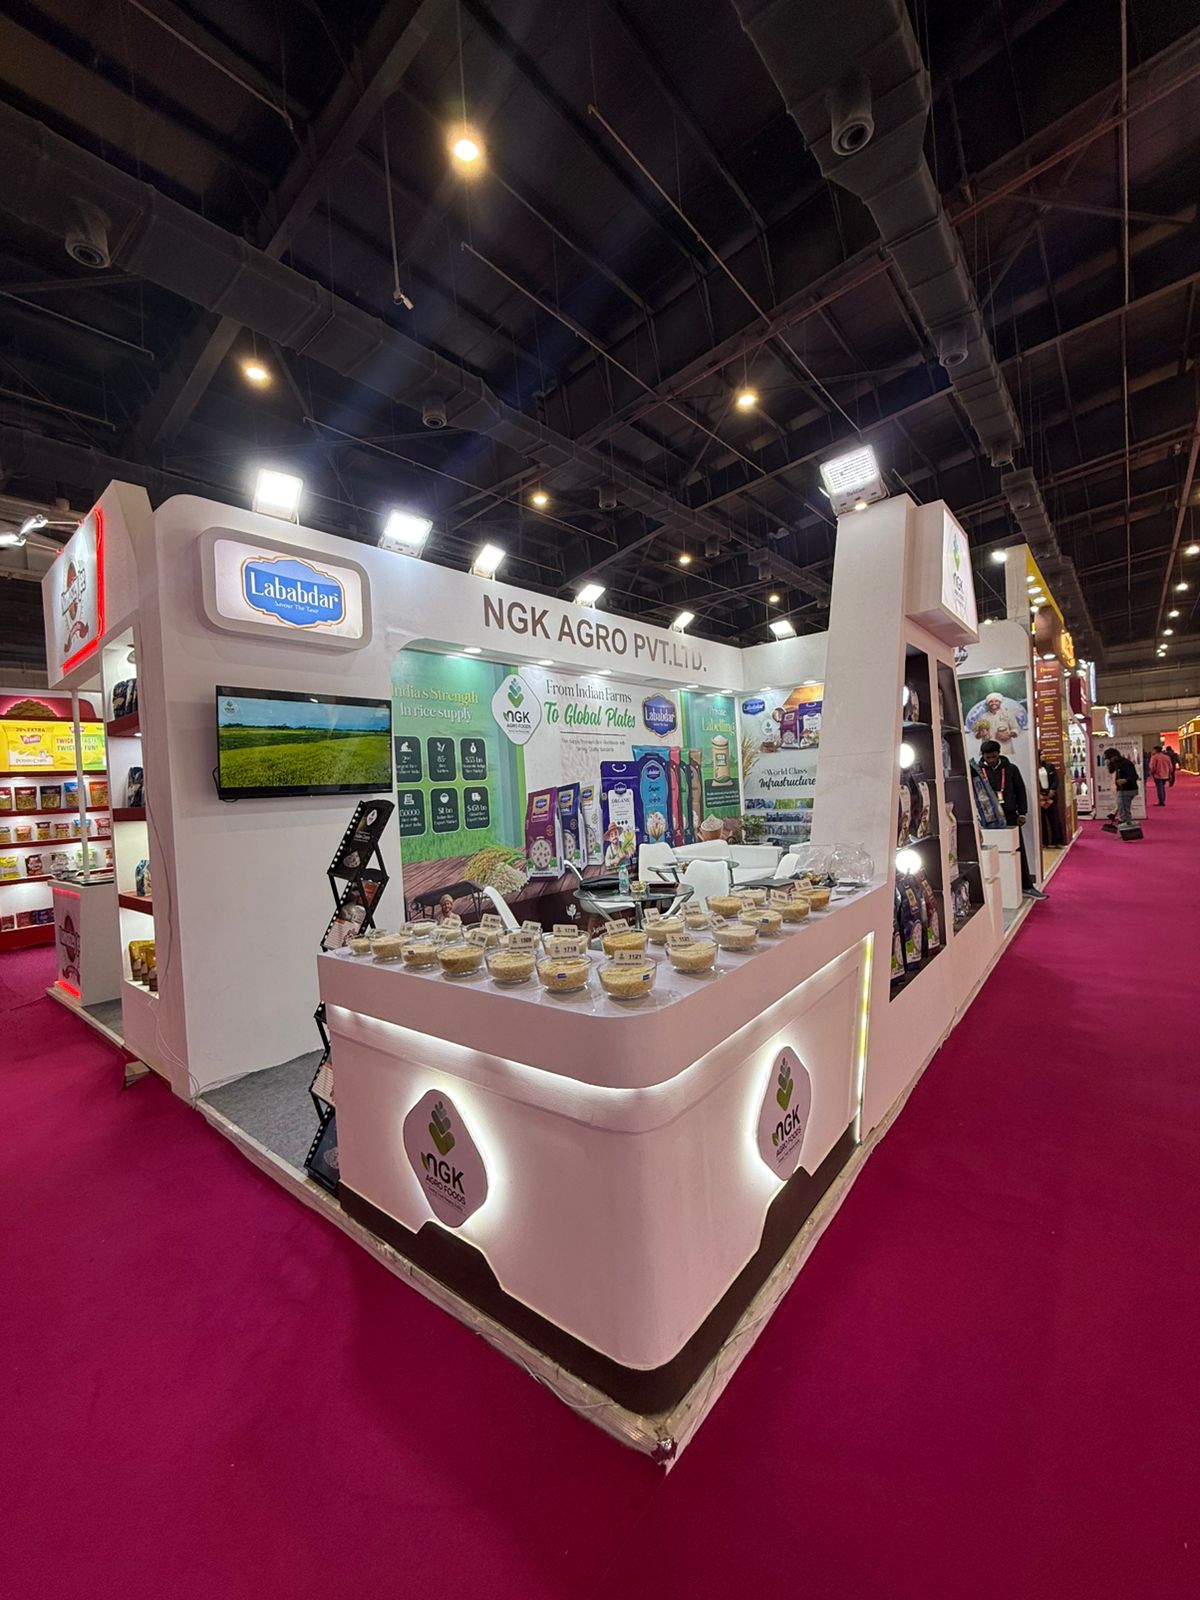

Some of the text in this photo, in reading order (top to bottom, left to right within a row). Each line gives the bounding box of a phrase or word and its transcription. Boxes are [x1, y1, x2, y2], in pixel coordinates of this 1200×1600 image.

[250, 571, 339, 609] Lababdar
[483, 594, 551, 640] NGK
[557, 614, 628, 656] AGRO
[546, 679, 632, 704] From Indian Farms
[438, 706, 472, 723] supply
[543, 701, 636, 729] To Global Plates
[759, 775, 816, 791] Infrastructure
